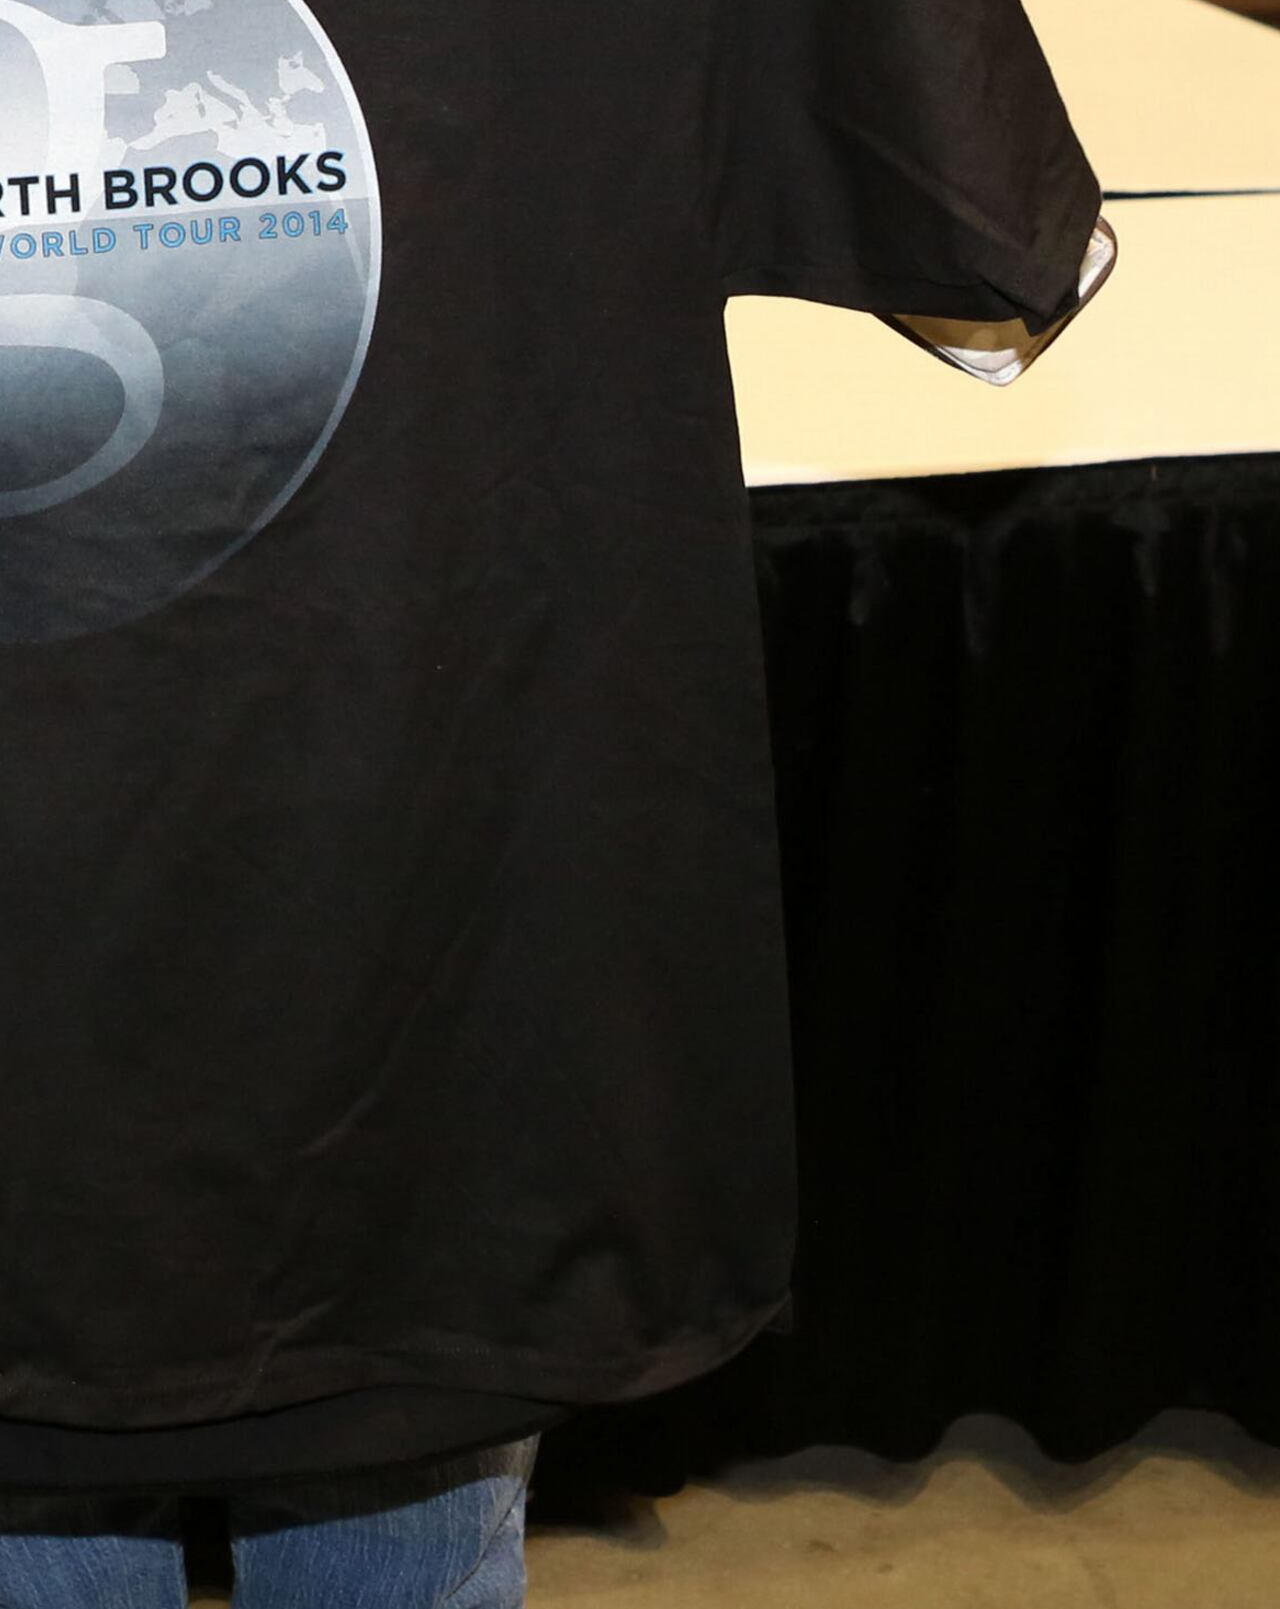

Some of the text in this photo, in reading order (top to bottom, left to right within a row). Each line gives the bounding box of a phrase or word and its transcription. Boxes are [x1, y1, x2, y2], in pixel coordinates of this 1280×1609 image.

[104, 151, 348, 211] BROOKS
[133, 216, 241, 250] TOUR
[258, 208, 348, 241] 2014
